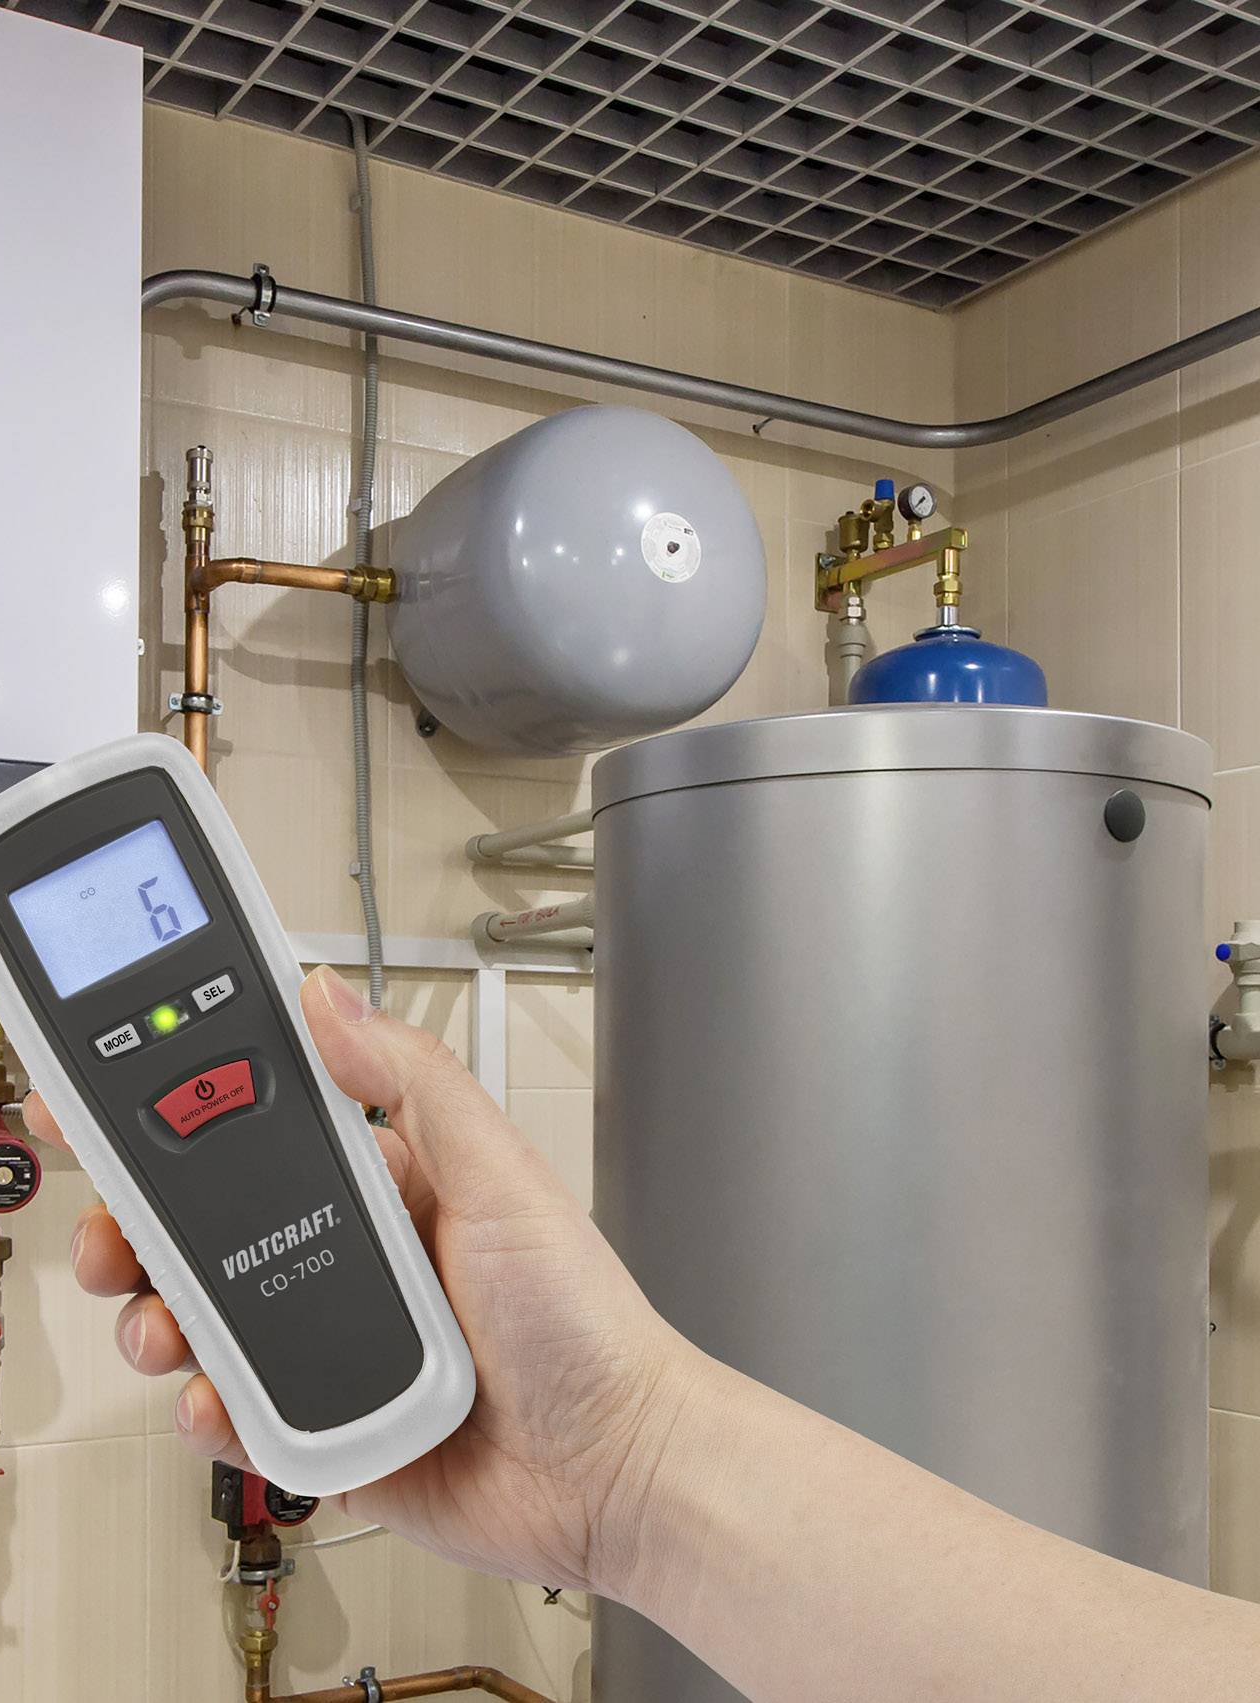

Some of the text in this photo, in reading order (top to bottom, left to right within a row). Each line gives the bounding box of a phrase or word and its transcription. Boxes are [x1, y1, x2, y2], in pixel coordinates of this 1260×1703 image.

[79, 887, 96, 900] CO
[137, 876, 182, 941] 6
[203, 984, 226, 1001] SEL
[103, 1030, 134, 1052] MODE
[180, 1085, 245, 1124] AUTO POWER OFF
[221, 1203, 334, 1280] VOLTCRAFT
[260, 1249, 335, 1297] CO-700
